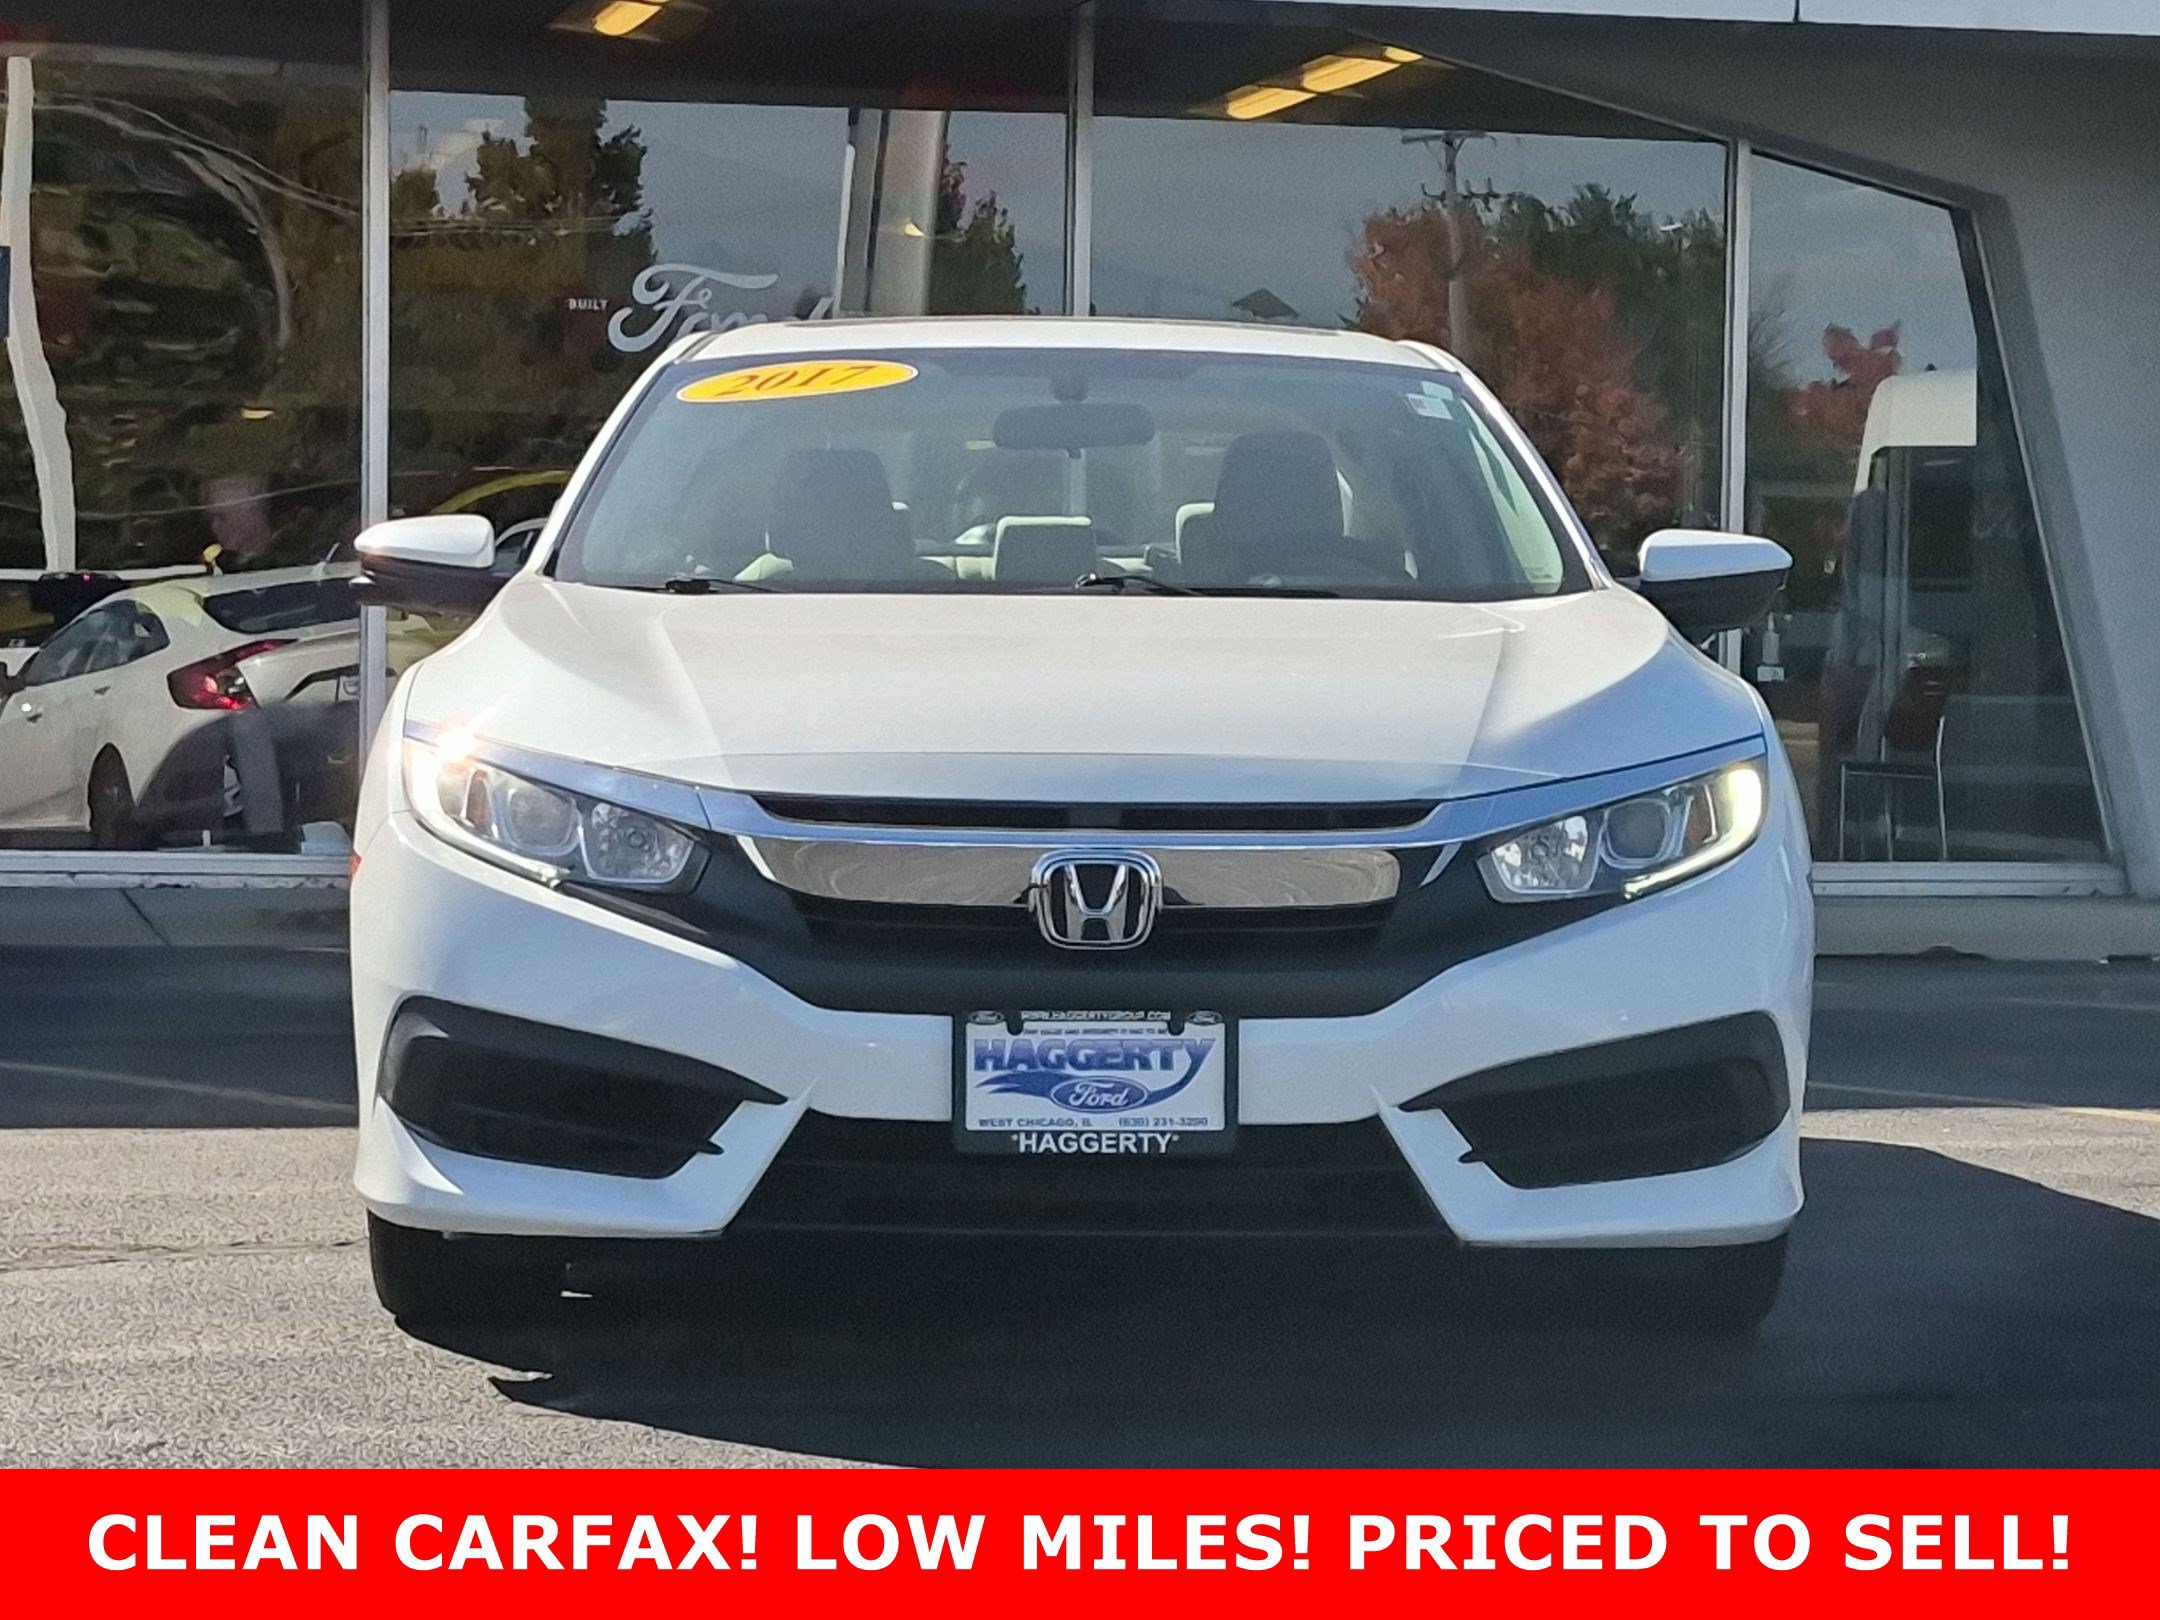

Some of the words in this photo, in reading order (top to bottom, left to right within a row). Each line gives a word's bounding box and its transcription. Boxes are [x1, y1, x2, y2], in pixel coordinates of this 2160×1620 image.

[567, 298, 610, 311] BUILT
[713, 364, 878, 397] 2017
[974, 1038, 1216, 1074] HAGGERTY
[1068, 1081, 1130, 1107] Ford
[979, 1118, 1013, 1128] WEST
